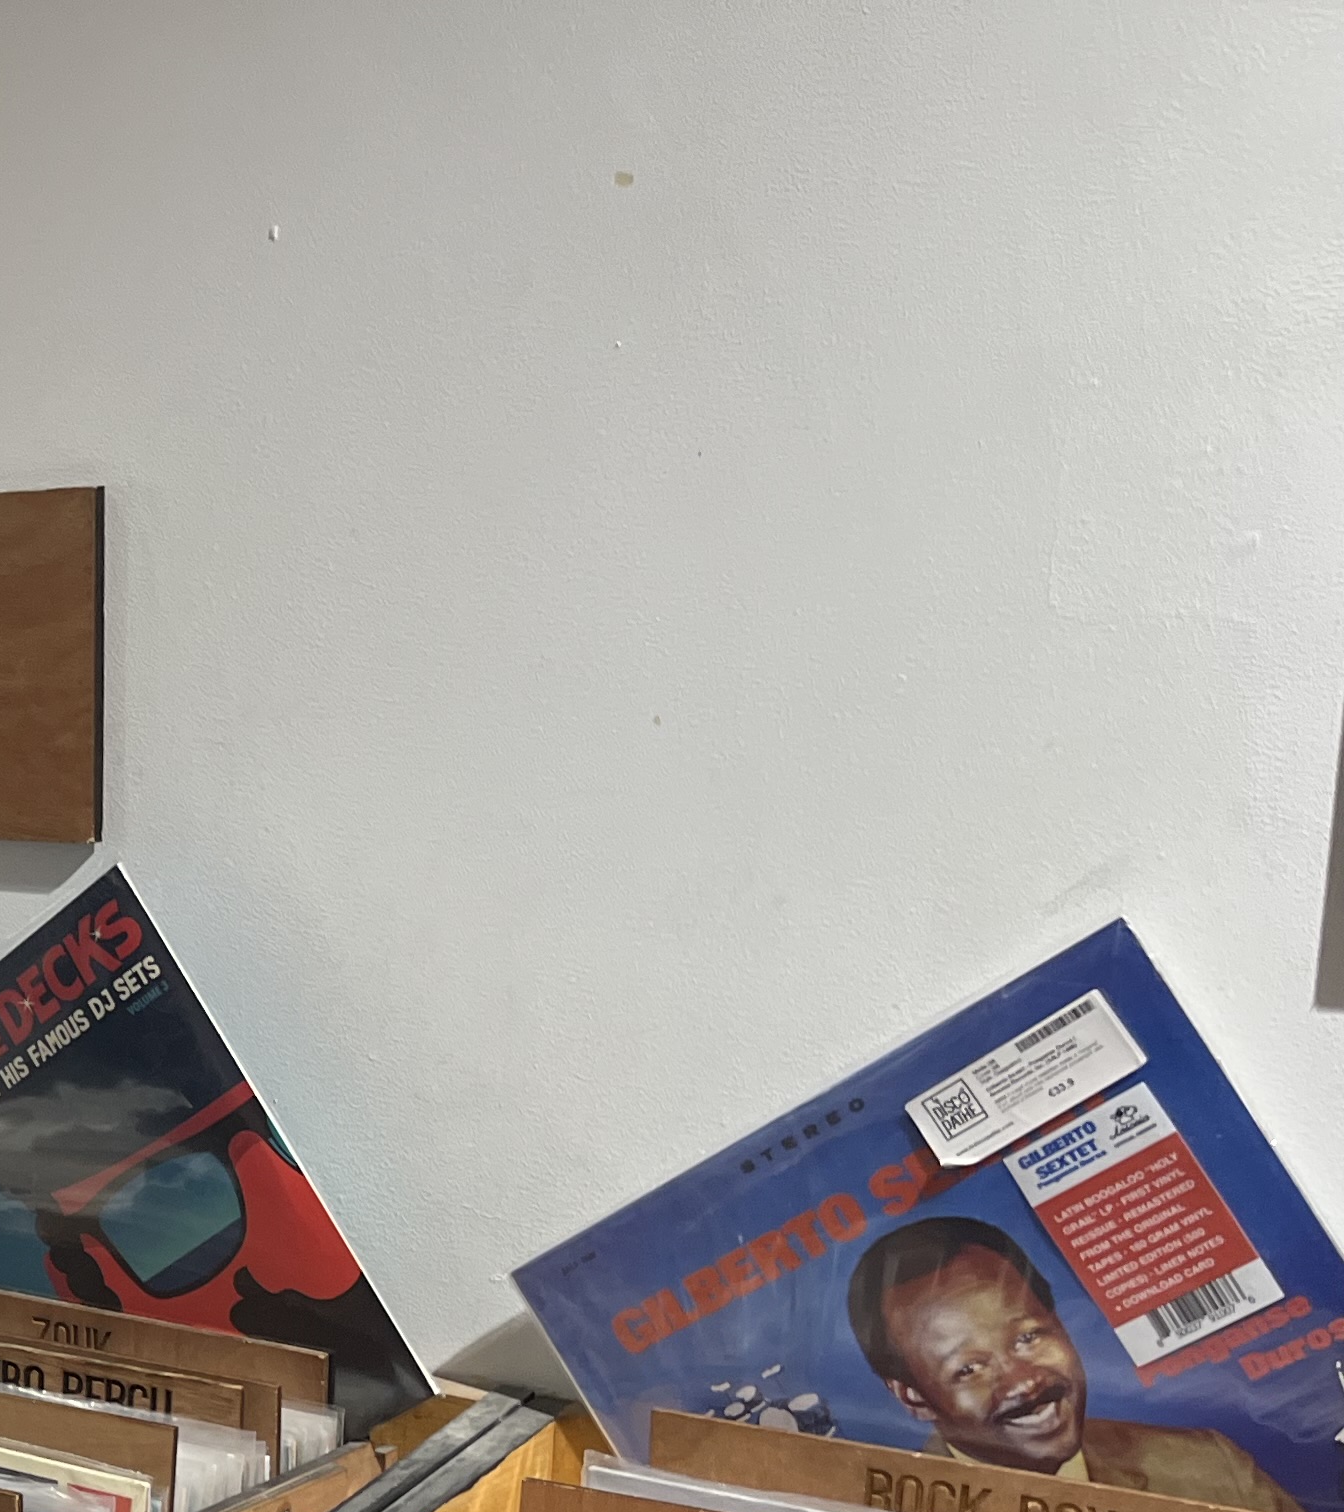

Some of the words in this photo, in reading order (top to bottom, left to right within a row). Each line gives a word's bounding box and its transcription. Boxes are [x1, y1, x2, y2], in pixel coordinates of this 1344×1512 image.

[26, 1008, 90, 1068] FAMOUS
[87, 988, 116, 1021] DJ
[113, 955, 162, 1002] SETS
[1018, 1121, 1097, 1170] GILBERTO
[1035, 1139, 1100, 1180] SEXTET
[1054, 1202, 1085, 1224] LATIN
[1084, 1170, 1145, 1208] BOOGALOO
[1070, 1219, 1118, 1250] REISSUE
[1123, 1178, 1196, 1223] REMASTERED
[1098, 1203, 1114, 1219] LP
[1120, 1185, 1152, 1207] FIRST
[1153, 1168, 1187, 1189] VINYL
[1080, 1241, 1112, 1262] FROM
[1113, 1228, 1134, 1247] THE
[1133, 1203, 1187, 1234] ORIGINAL
[1087, 1251, 1124, 1274] TAPES
[1147, 1224, 1180, 1246] GRAM
[1180, 1206, 1215, 1229] VINYL
[1153, 1253, 1188, 1277] LINER
[1187, 1233, 1227, 1259] NOTES
[613, 1191, 868, 1356] GILBERTO
[1096, 1259, 1139, 1288] LIMITED
[1138, 1237, 1184, 1267] EDITION
[1122, 1272, 1184, 1310] DOWNLOAD
[1183, 1256, 1216, 1279] CARD
